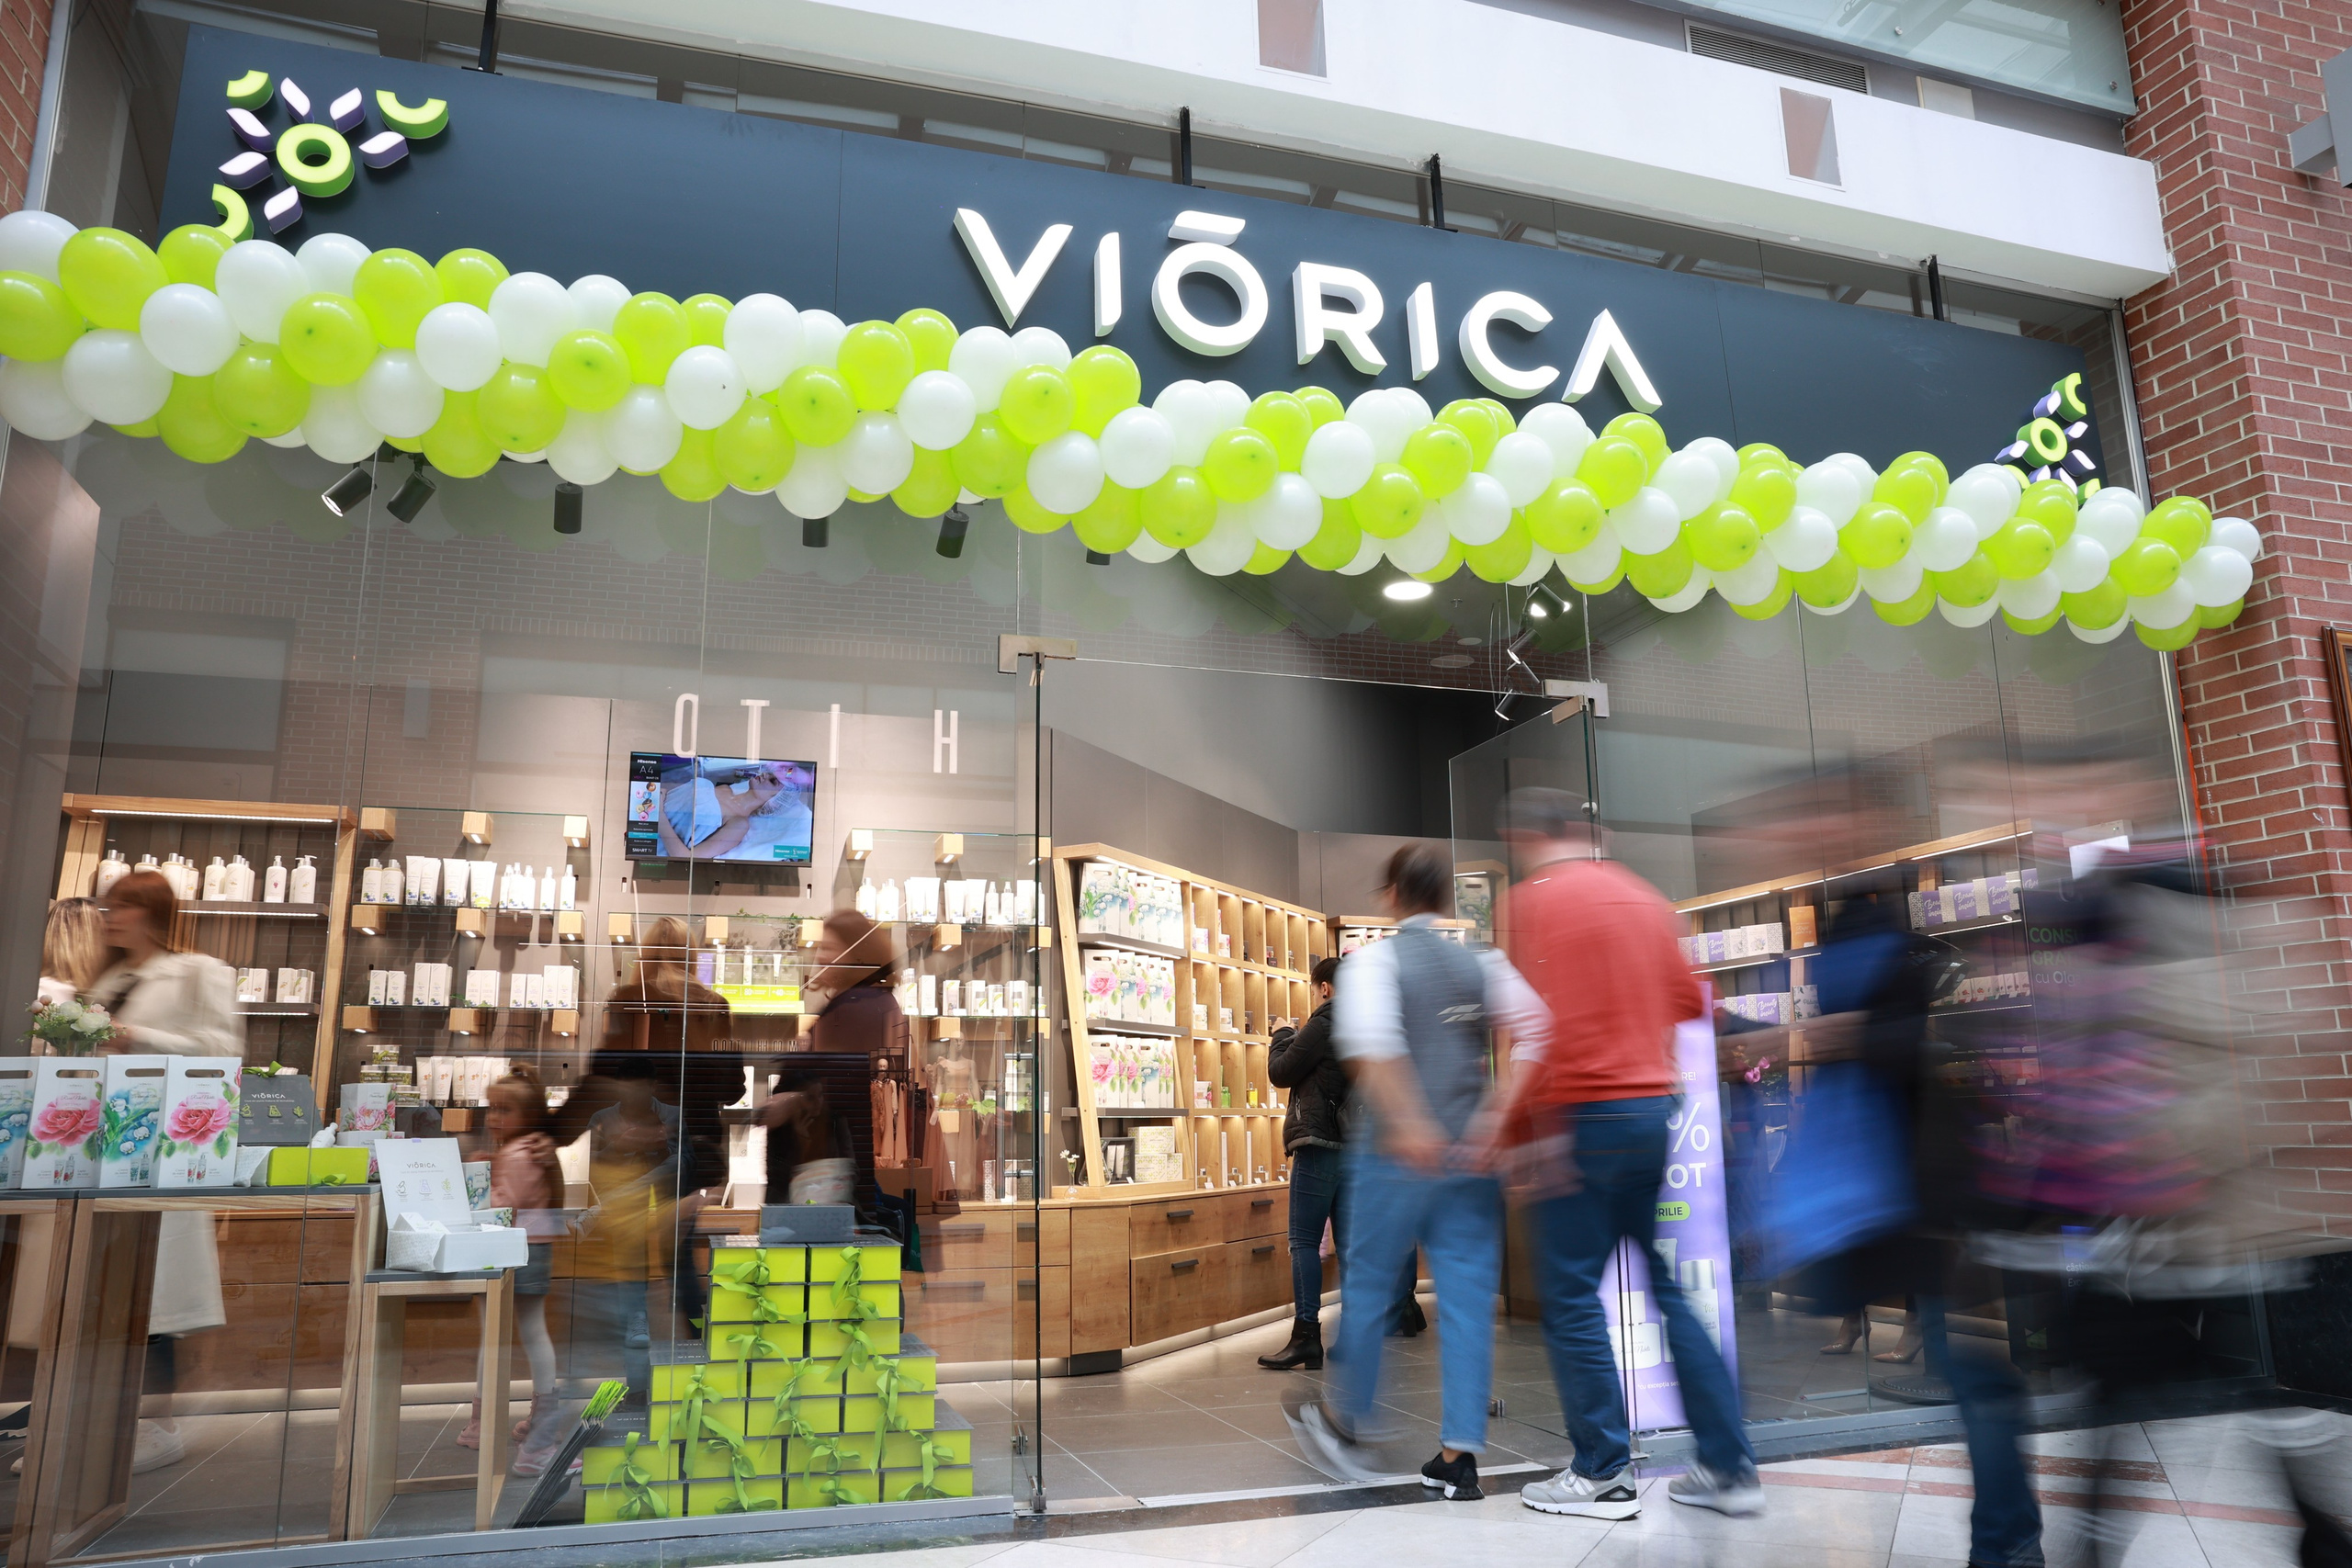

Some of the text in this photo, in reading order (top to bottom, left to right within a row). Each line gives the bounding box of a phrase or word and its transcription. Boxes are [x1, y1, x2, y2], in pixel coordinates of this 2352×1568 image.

[639, 765, 654, 774] A4
[2035, 973, 2051, 984] cu
[1757, 998, 1778, 1010] Beauty
[1759, 1007, 1775, 1017] inside
[1654, 1206, 1683, 1216] PRILIE
